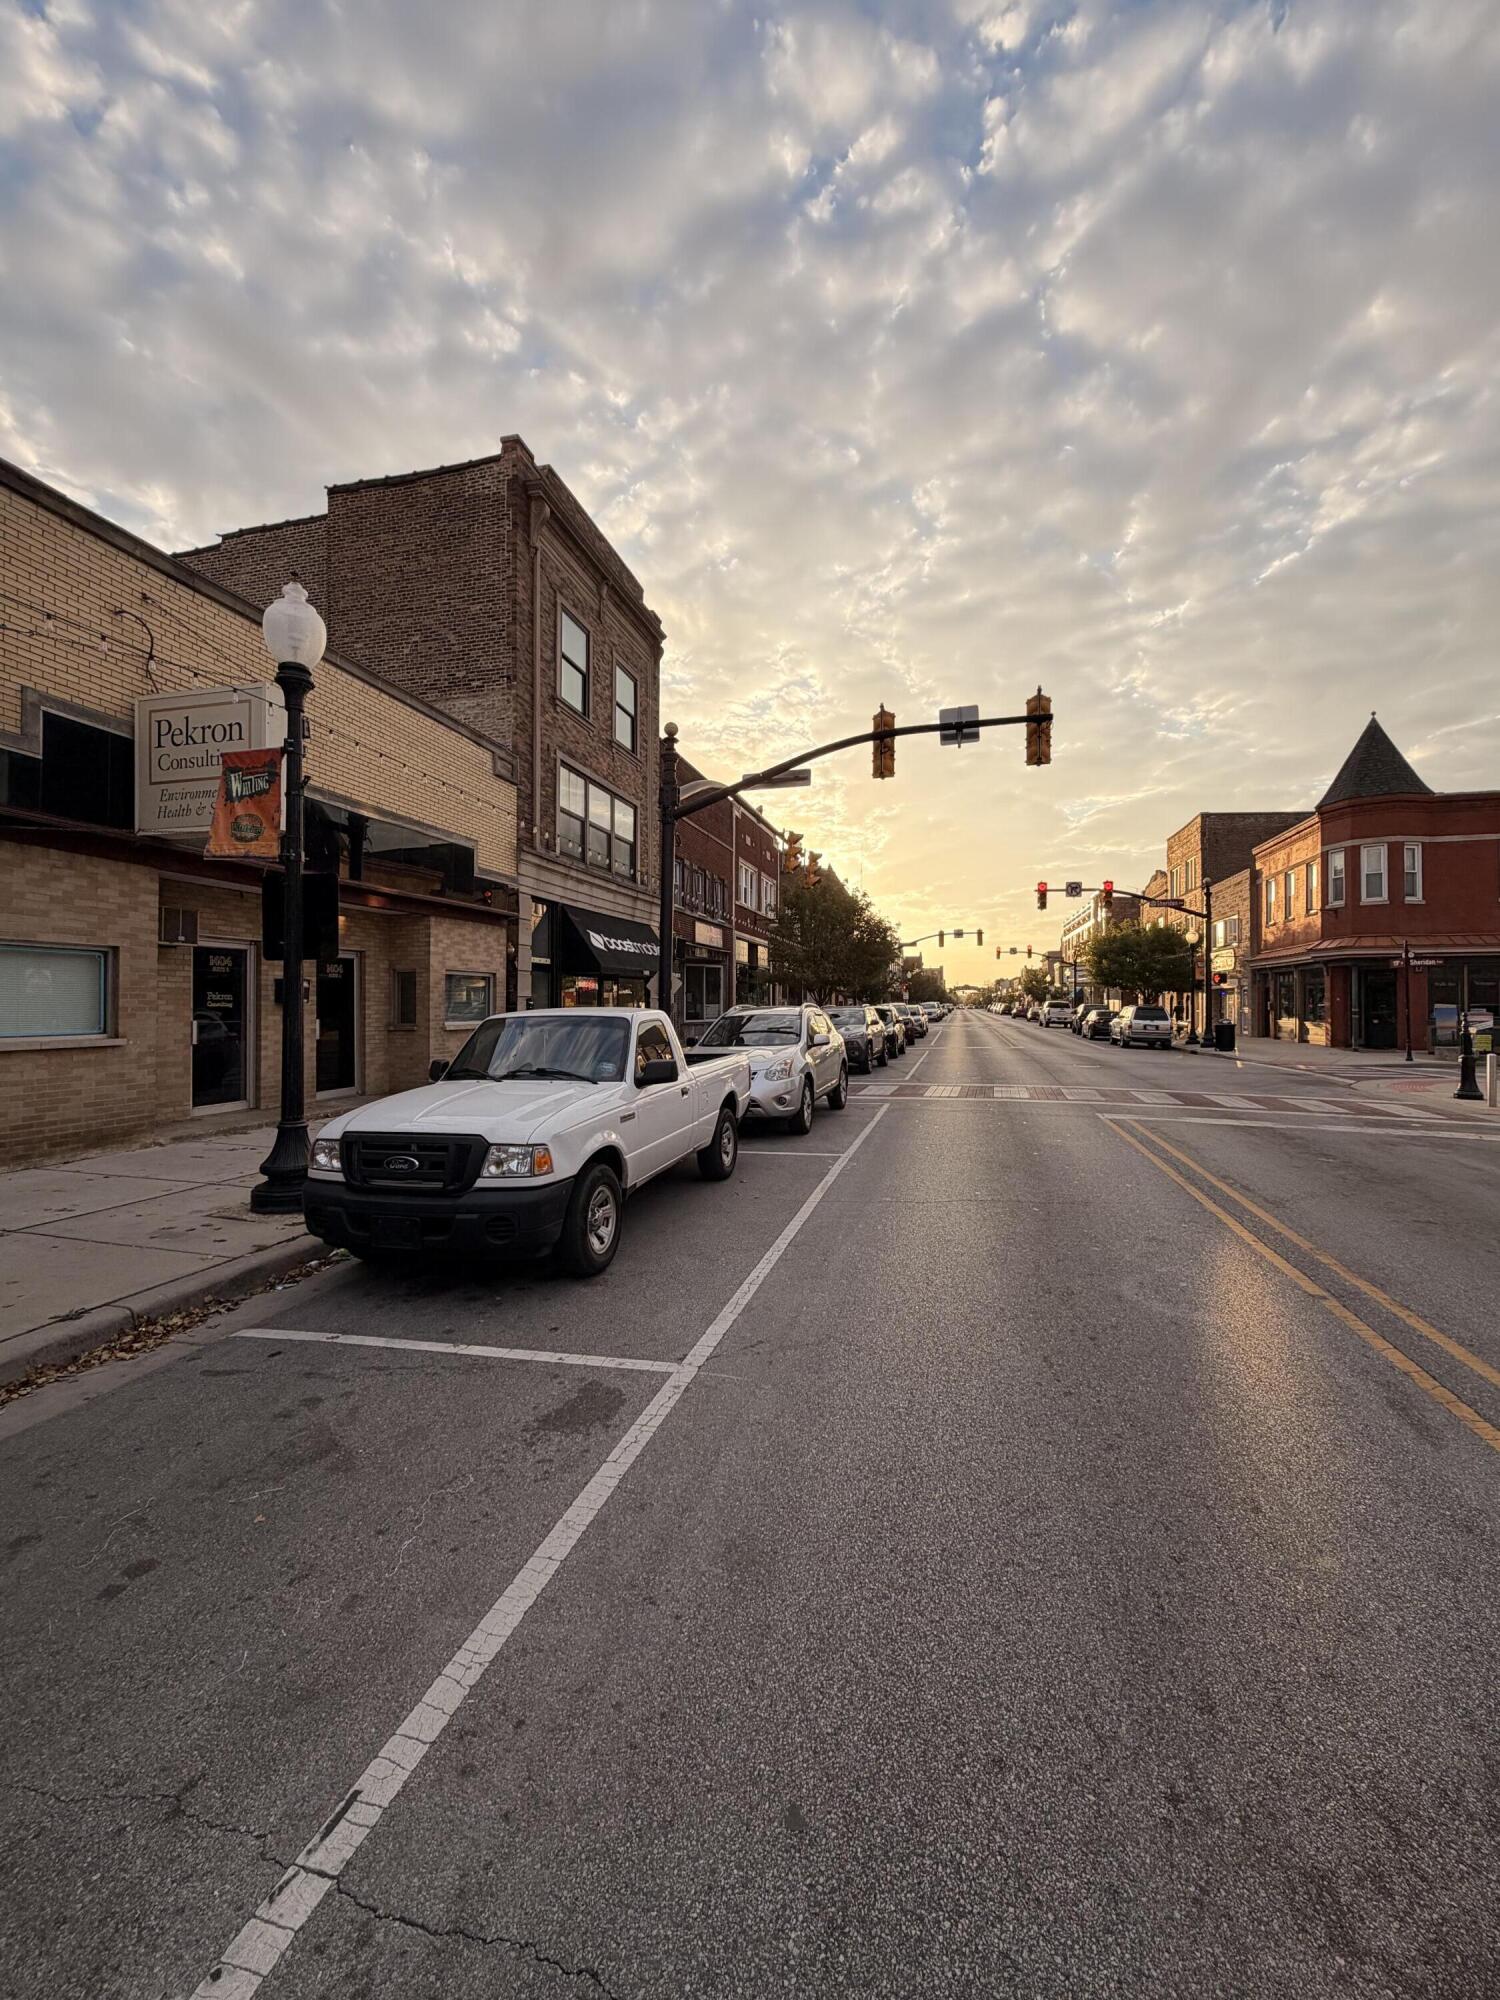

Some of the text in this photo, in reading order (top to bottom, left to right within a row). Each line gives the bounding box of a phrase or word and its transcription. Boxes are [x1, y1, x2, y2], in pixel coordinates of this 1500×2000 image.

[154, 716, 244, 749] Pekron
[158, 749, 222, 771] Consulti
[160, 787, 218, 802] Environme
[157, 803, 192, 819] Health
[196, 801, 206, 816] &
